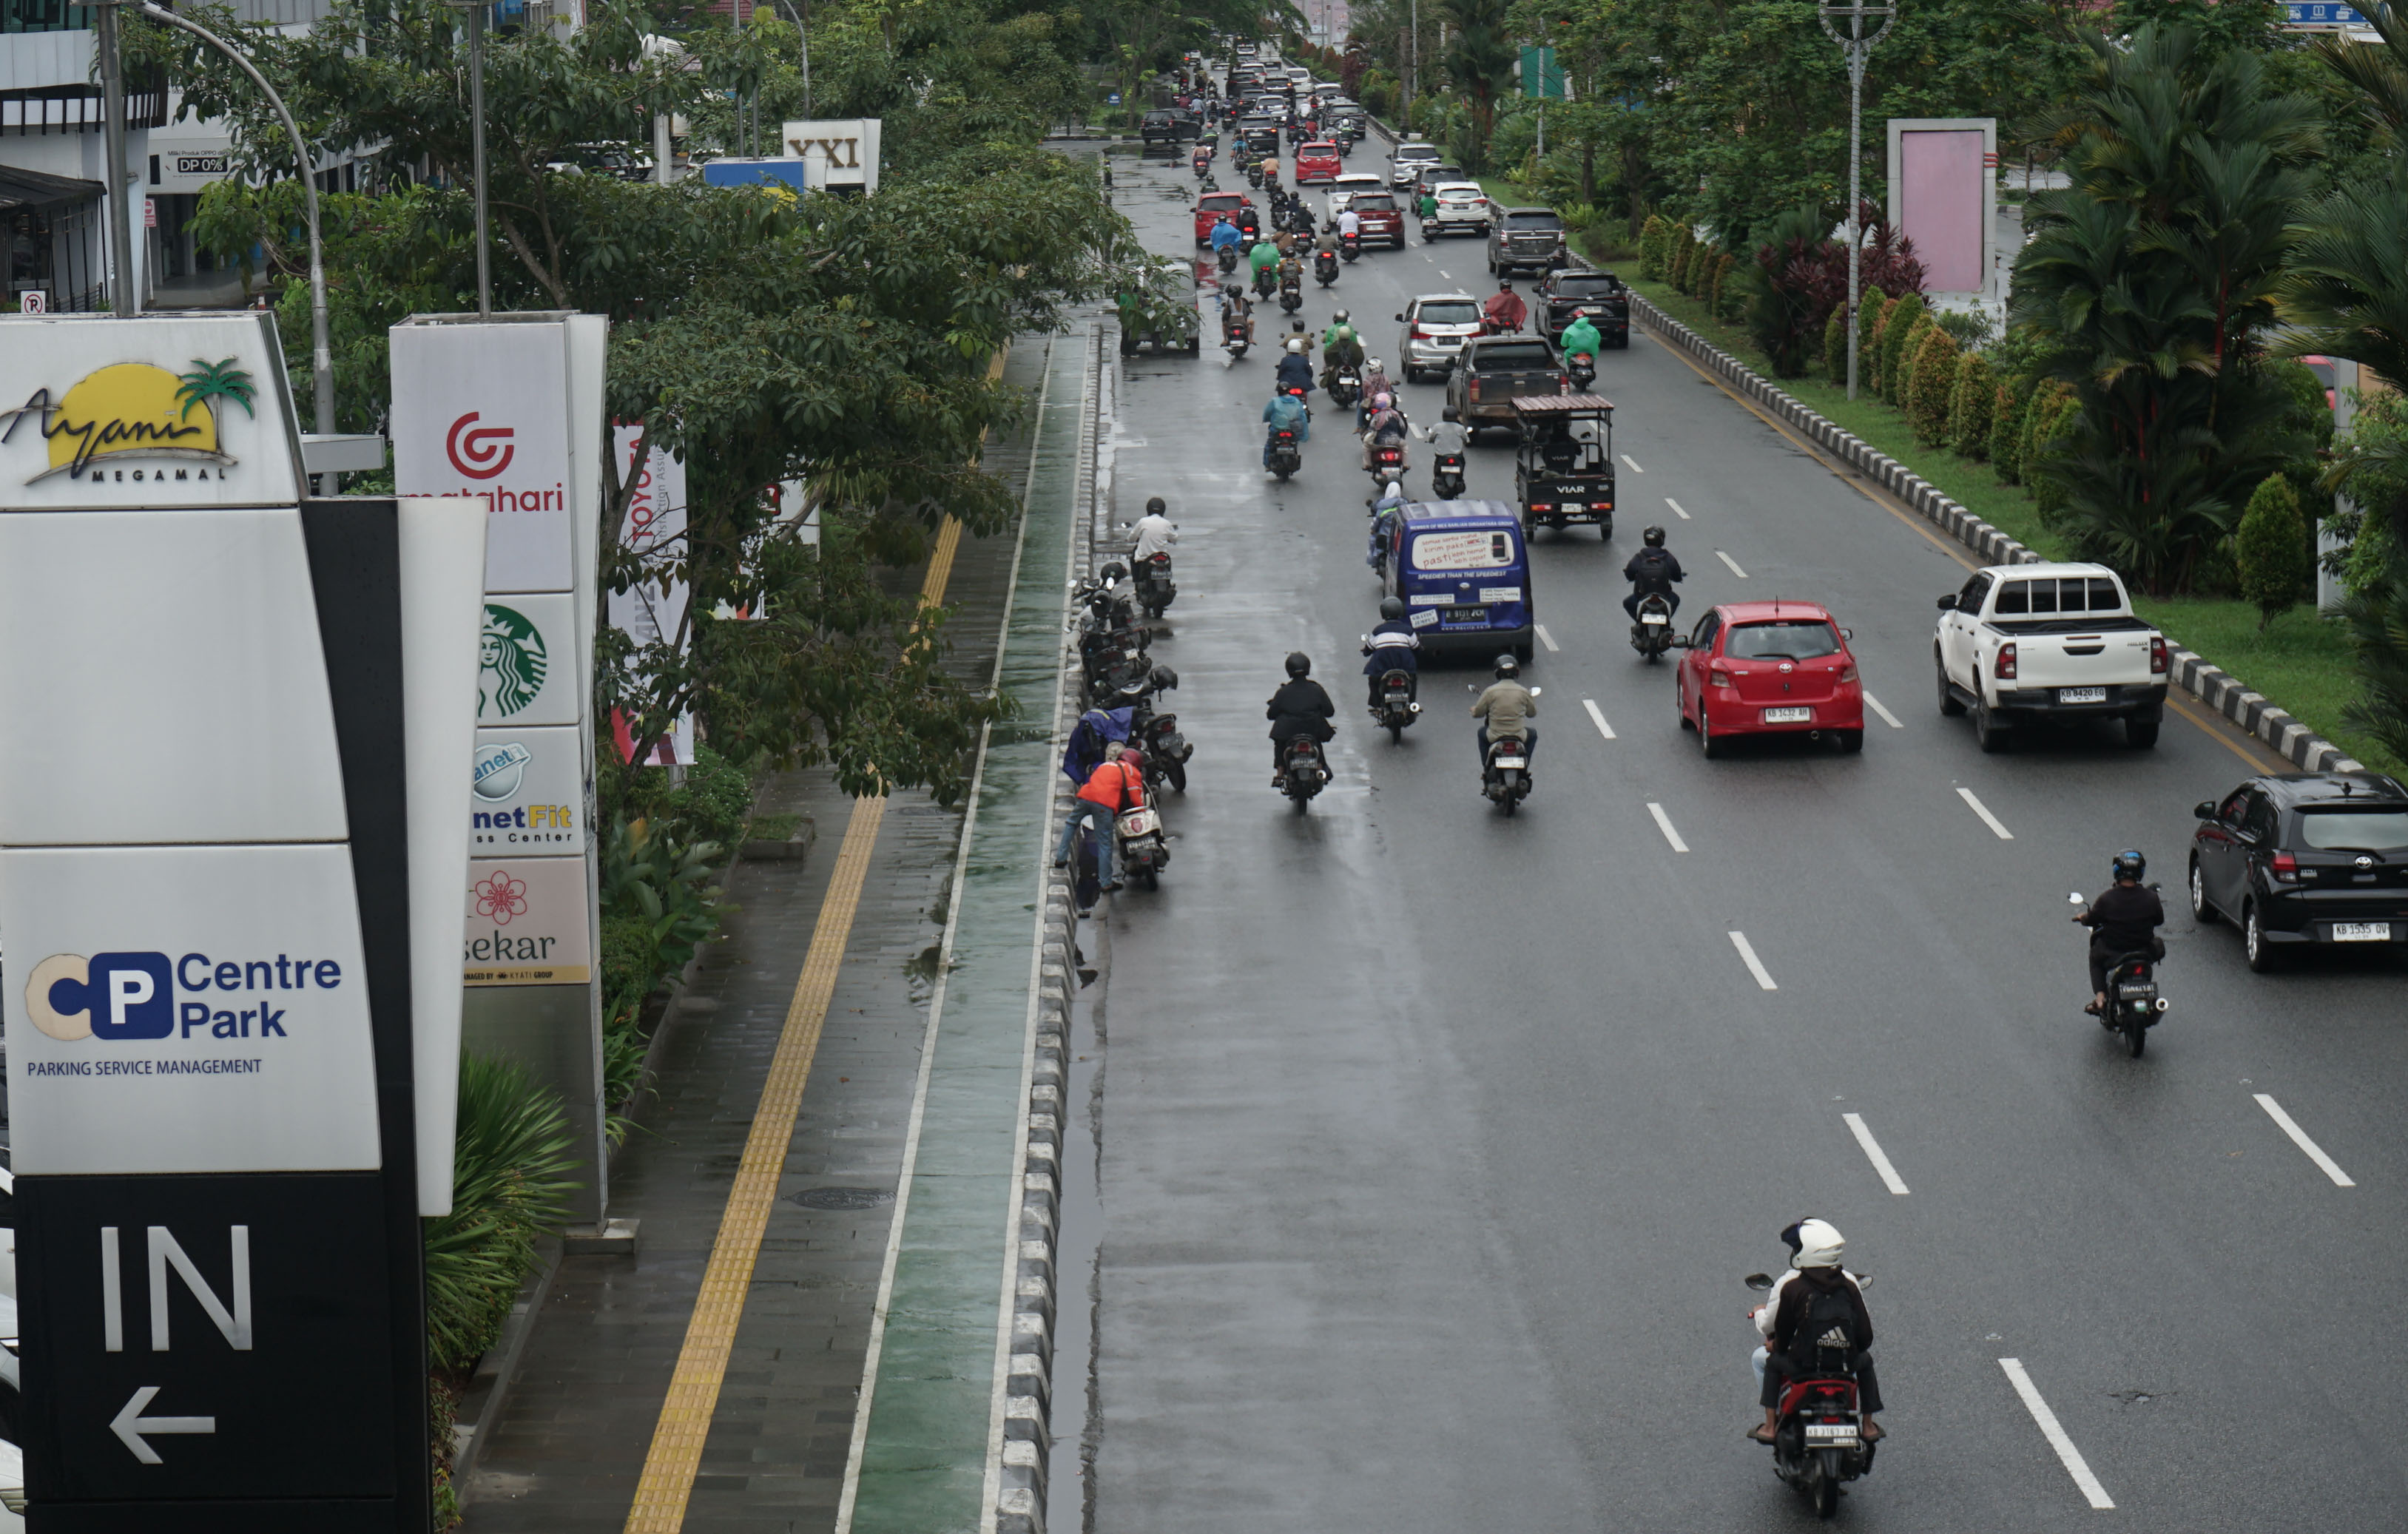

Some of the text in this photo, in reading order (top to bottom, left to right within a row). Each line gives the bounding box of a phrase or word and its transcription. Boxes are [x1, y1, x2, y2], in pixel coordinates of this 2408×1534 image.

[180, 159, 223, 171] DP 0%
[1556, 485, 1585, 493] VIAR
[1423, 545, 1444, 553] kirim
[1423, 554, 1451, 570] pasti
[1767, 709, 1776, 717] KB
[508, 832, 572, 843] Center
[2336, 924, 2347, 935] KB
[2349, 924, 2372, 934] 1535
[177, 953, 342, 992] Centre
[510, 971, 532, 979] KYATI
[180, 1001, 289, 1039] Park
[27, 1058, 263, 1076] PARKING SERVICE MANAGEMENT
[101, 1225, 253, 1352] IN
[1817, 1337, 1851, 1348] adidas
